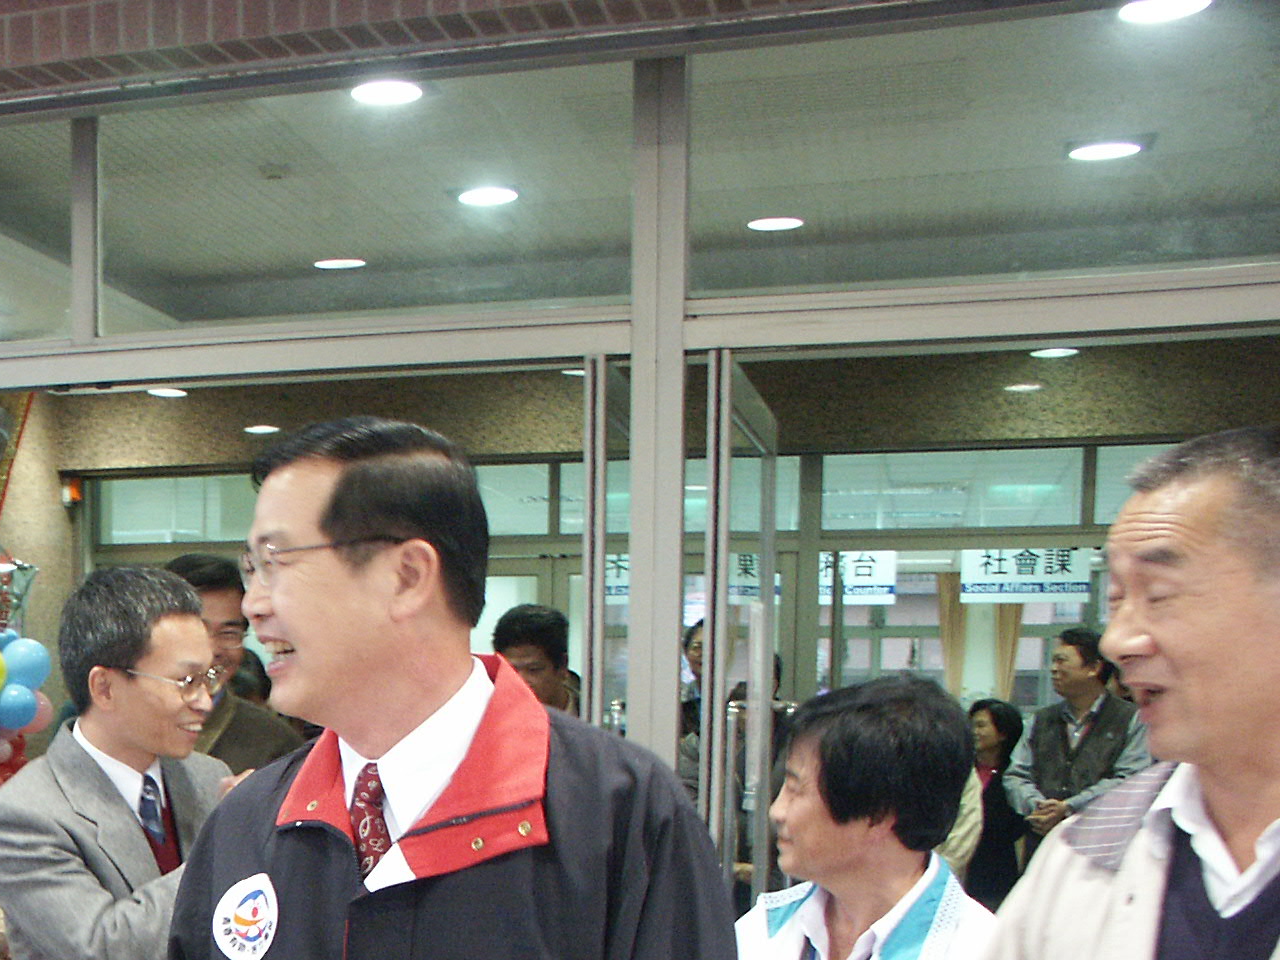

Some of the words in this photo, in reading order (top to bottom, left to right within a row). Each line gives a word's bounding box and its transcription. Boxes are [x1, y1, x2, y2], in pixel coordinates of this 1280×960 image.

[979, 548, 1072, 576] 社會課
[964, 583, 1000, 593] Social
[1002, 583, 1040, 593] Affairs
[1042, 582, 1088, 593] Section
